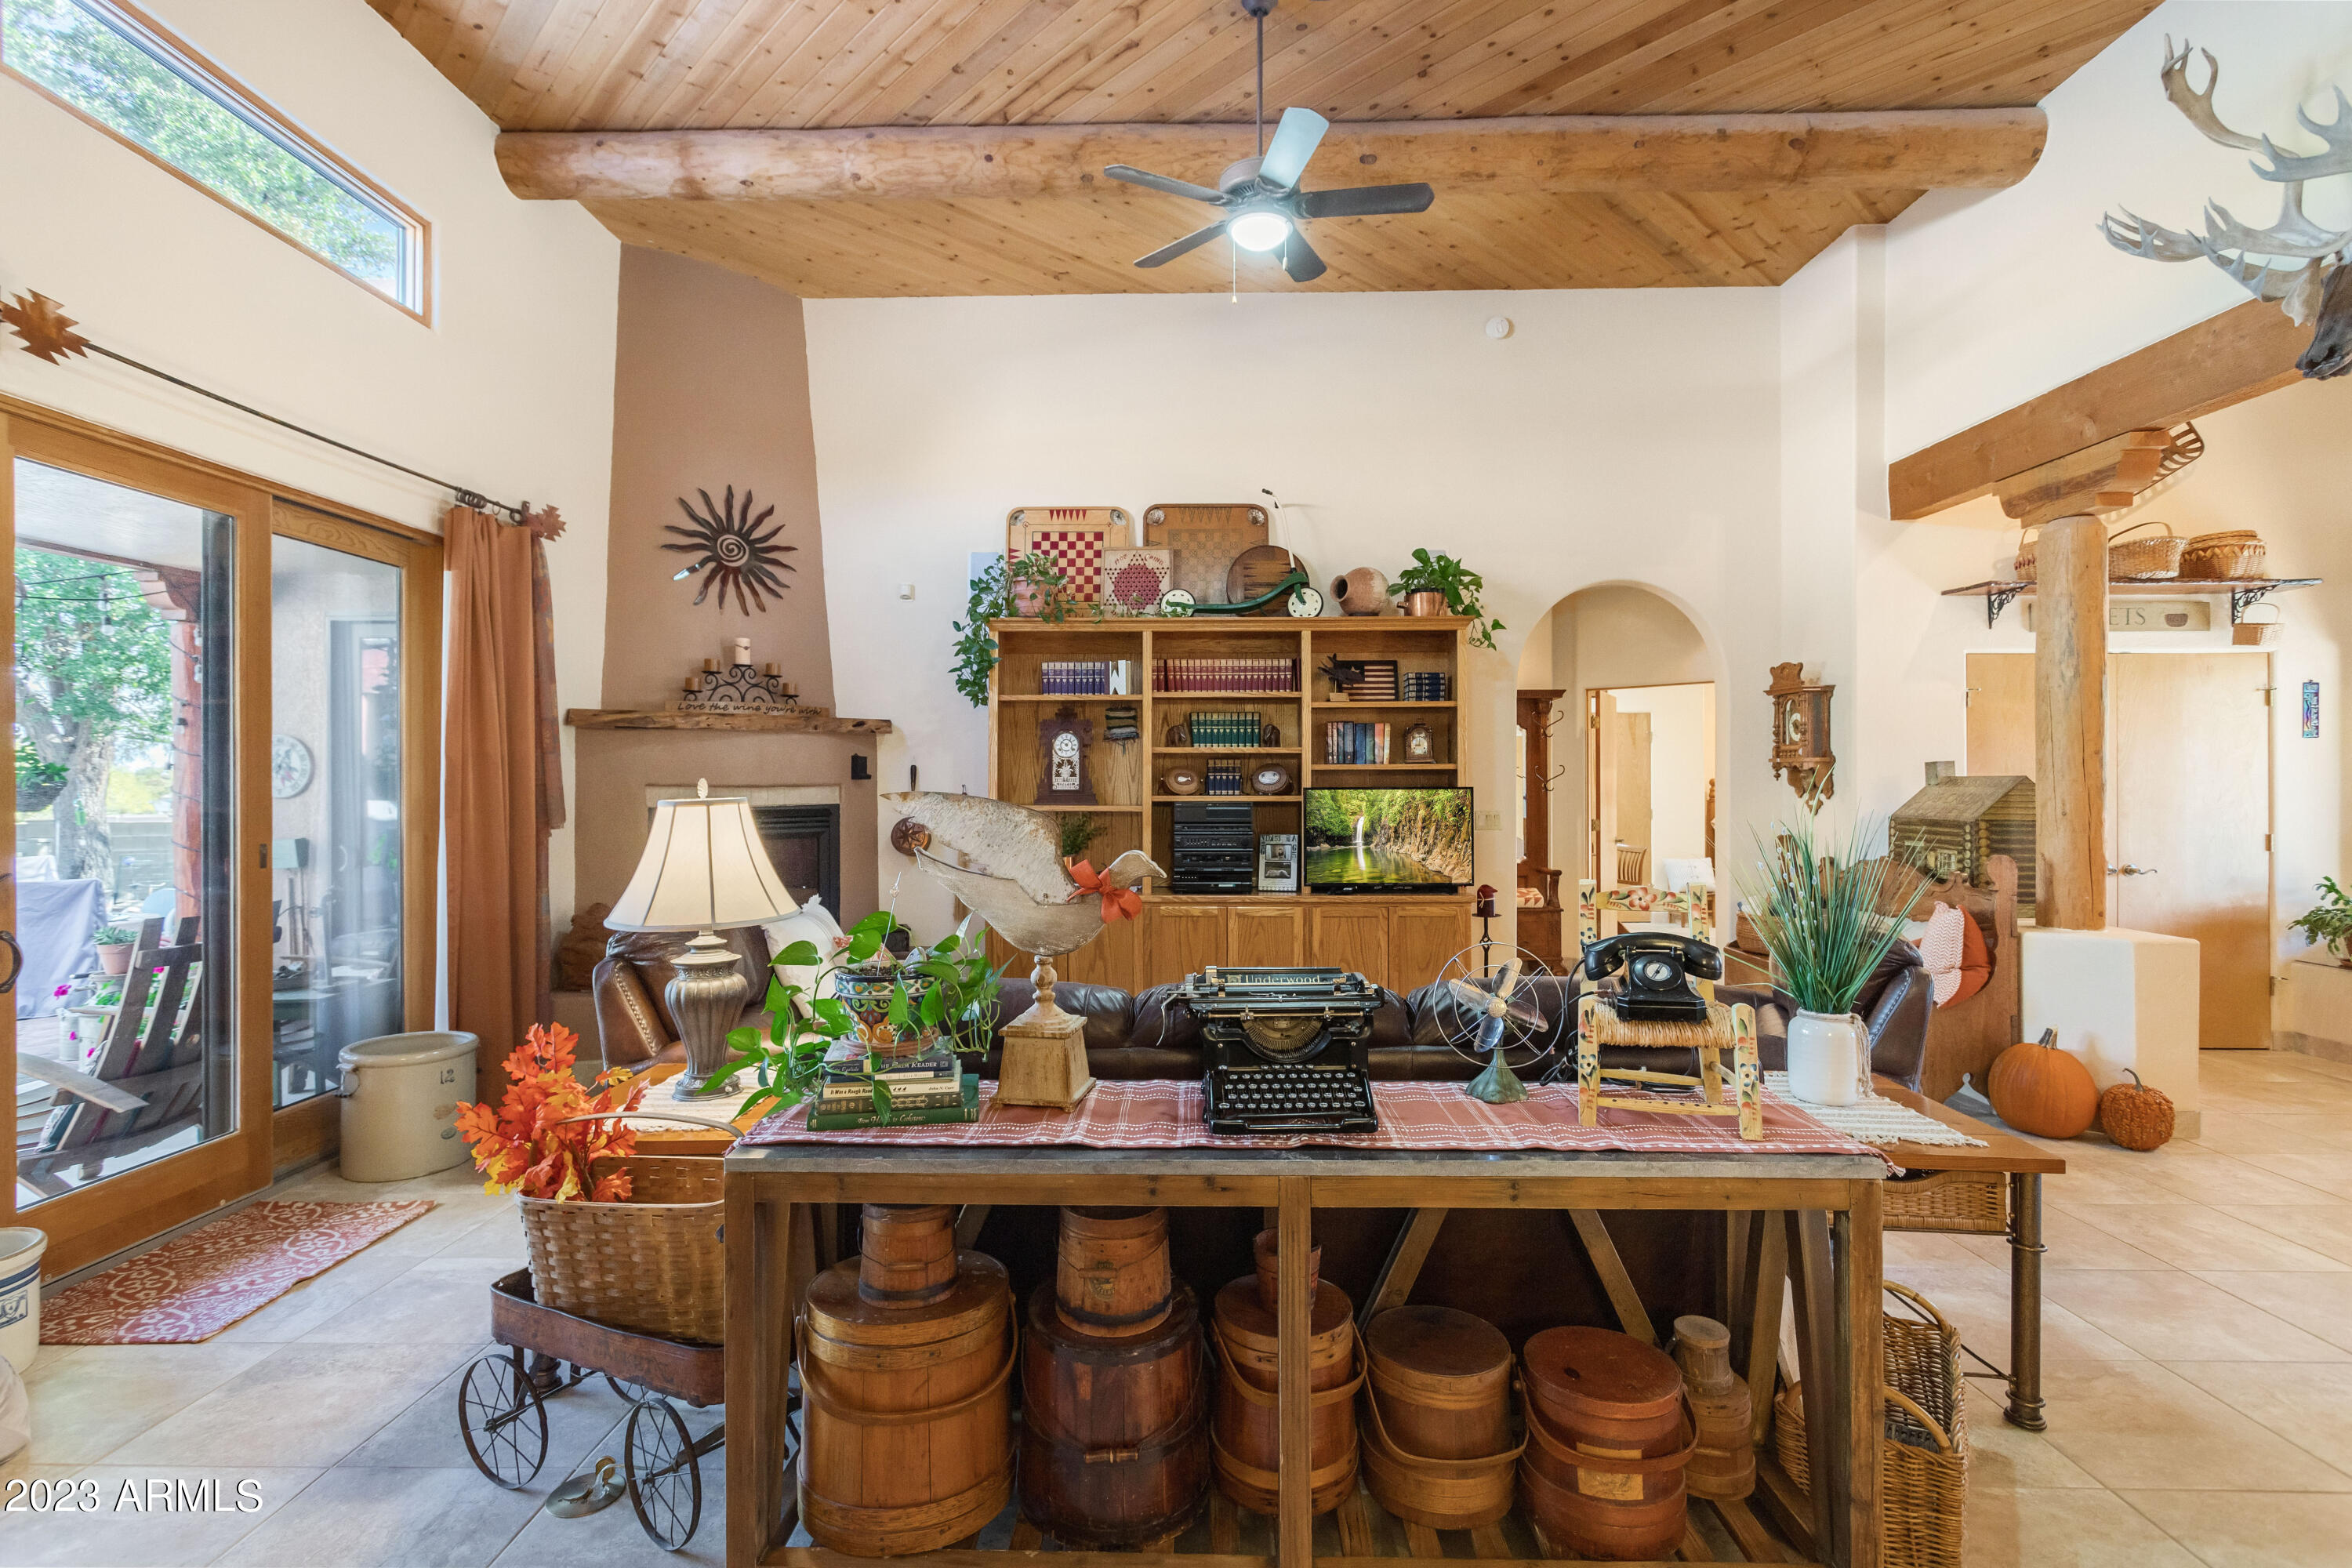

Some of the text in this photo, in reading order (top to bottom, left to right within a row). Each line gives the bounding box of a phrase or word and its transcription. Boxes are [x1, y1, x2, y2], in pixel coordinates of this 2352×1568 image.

[2109, 607, 2146, 626] ETS
[709, 702, 729, 711] the
[1245, 975, 1320, 983] Underwood
[440, 1069, 455, 1084] 12
